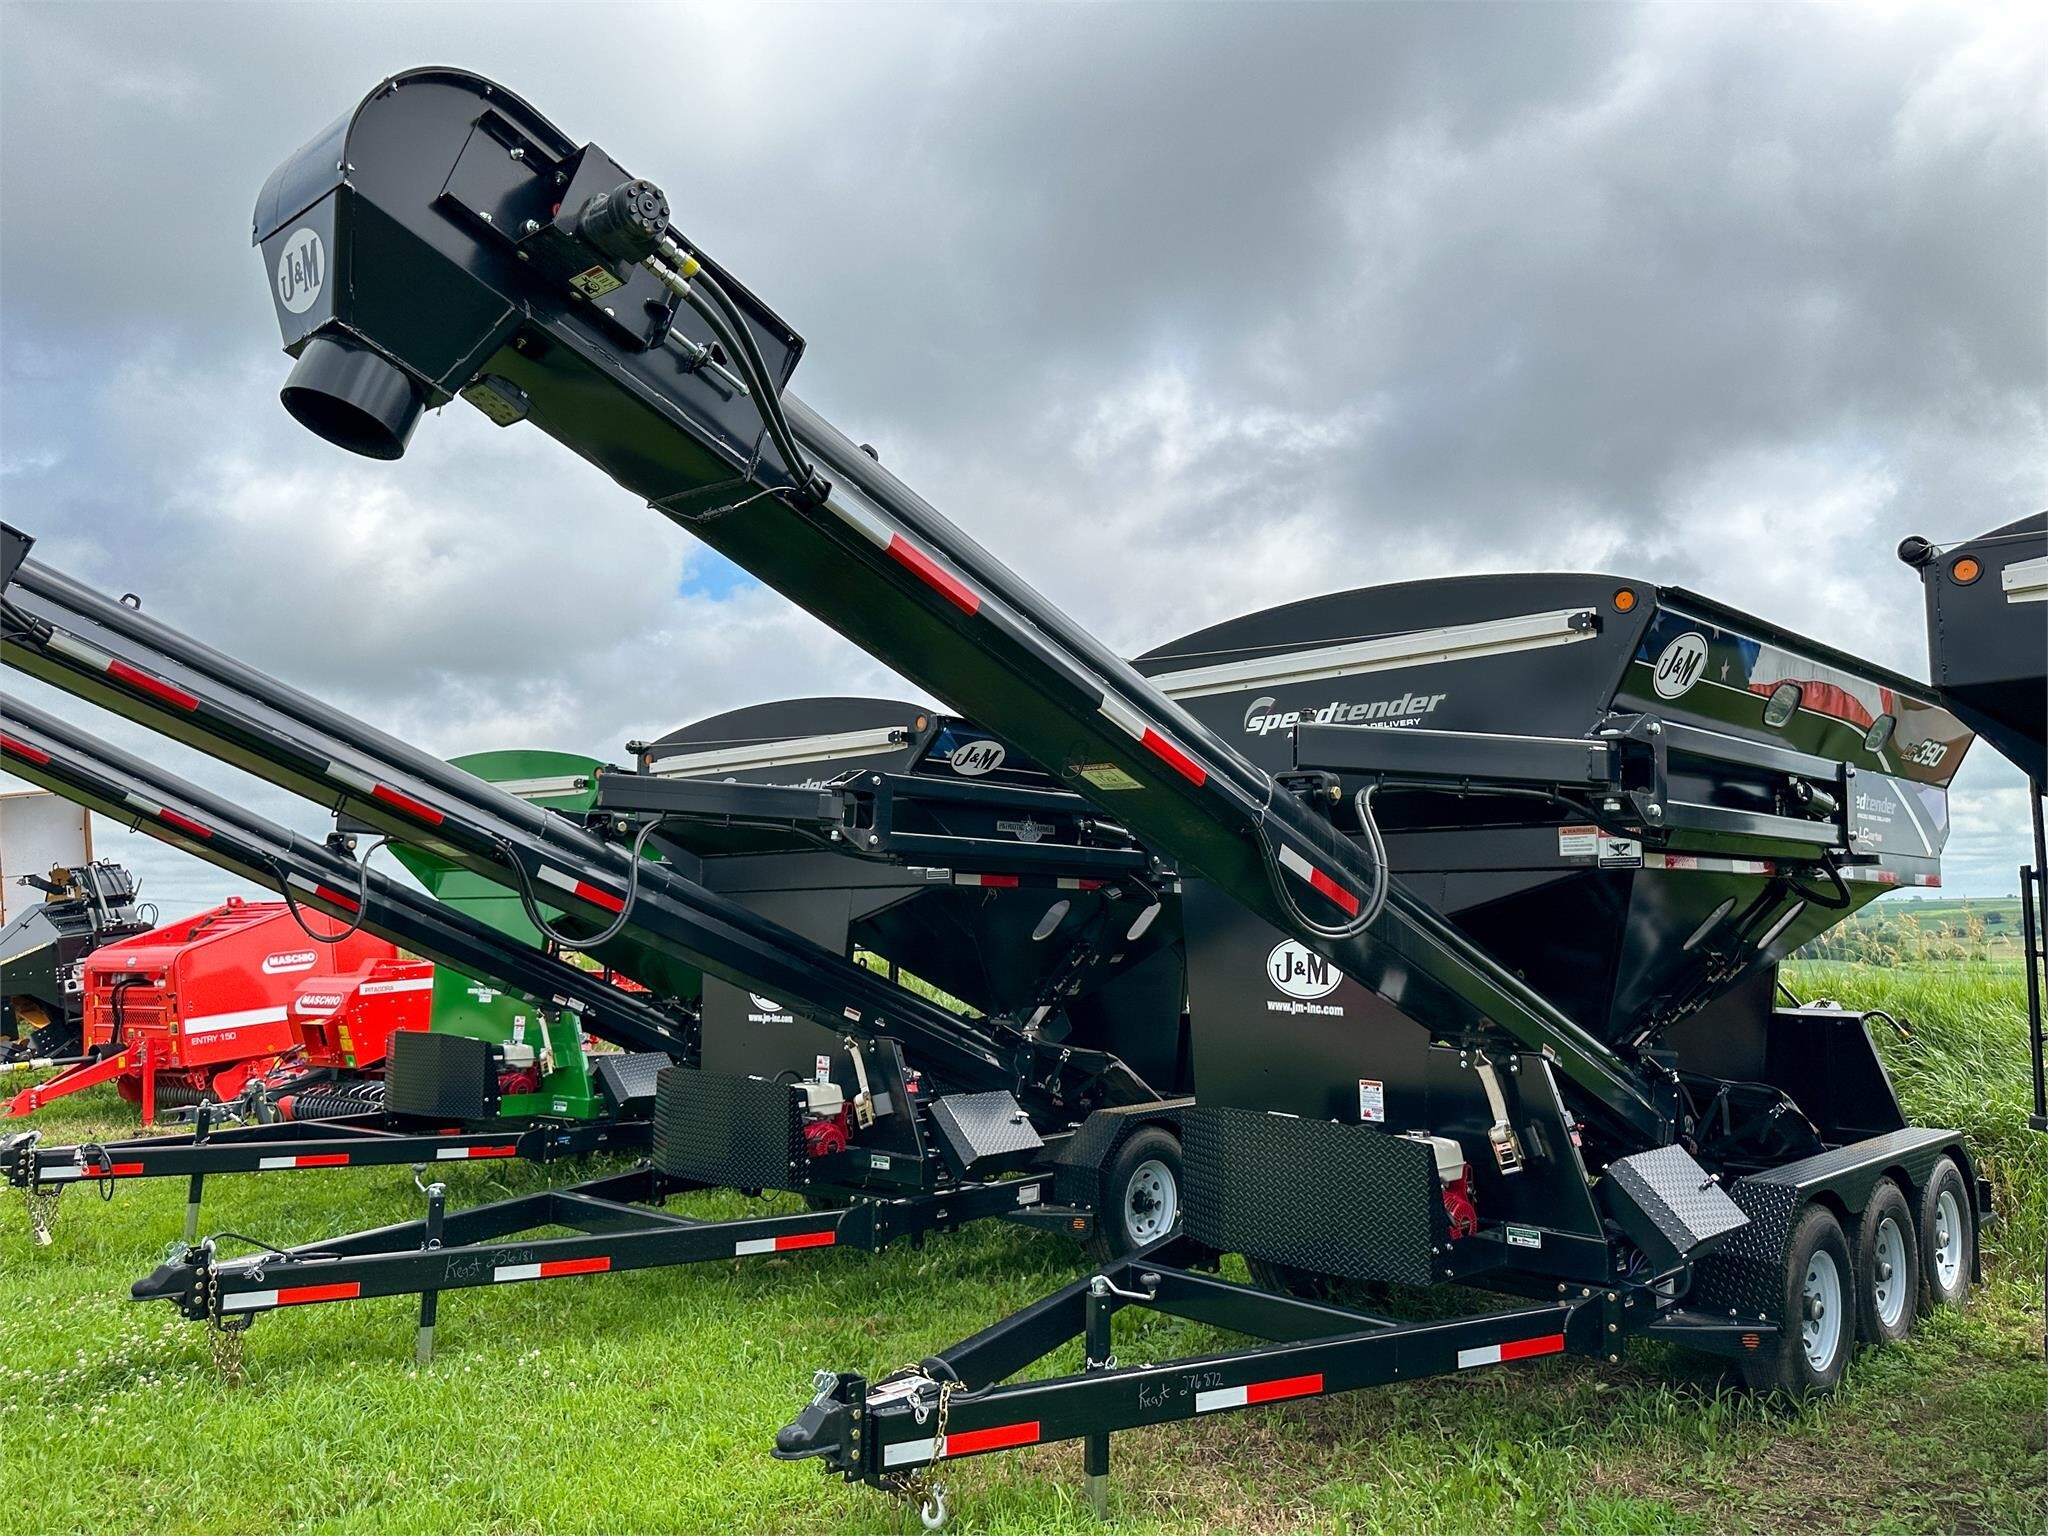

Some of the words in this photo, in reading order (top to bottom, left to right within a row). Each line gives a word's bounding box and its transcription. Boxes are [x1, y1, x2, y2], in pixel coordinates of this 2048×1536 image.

[281, 237, 320, 302] J&M
[1659, 646, 1703, 686] J&M
[954, 746, 1001, 770] J&M
[269, 952, 316, 966] MASCHIO
[1275, 951, 1330, 986] J&M
[301, 995, 341, 1006] MASCHIO
[1267, 1001, 1344, 1016] www.jm-inc.com
[191, 1035, 218, 1046] ENTRY
[219, 1032, 237, 1041] 150
